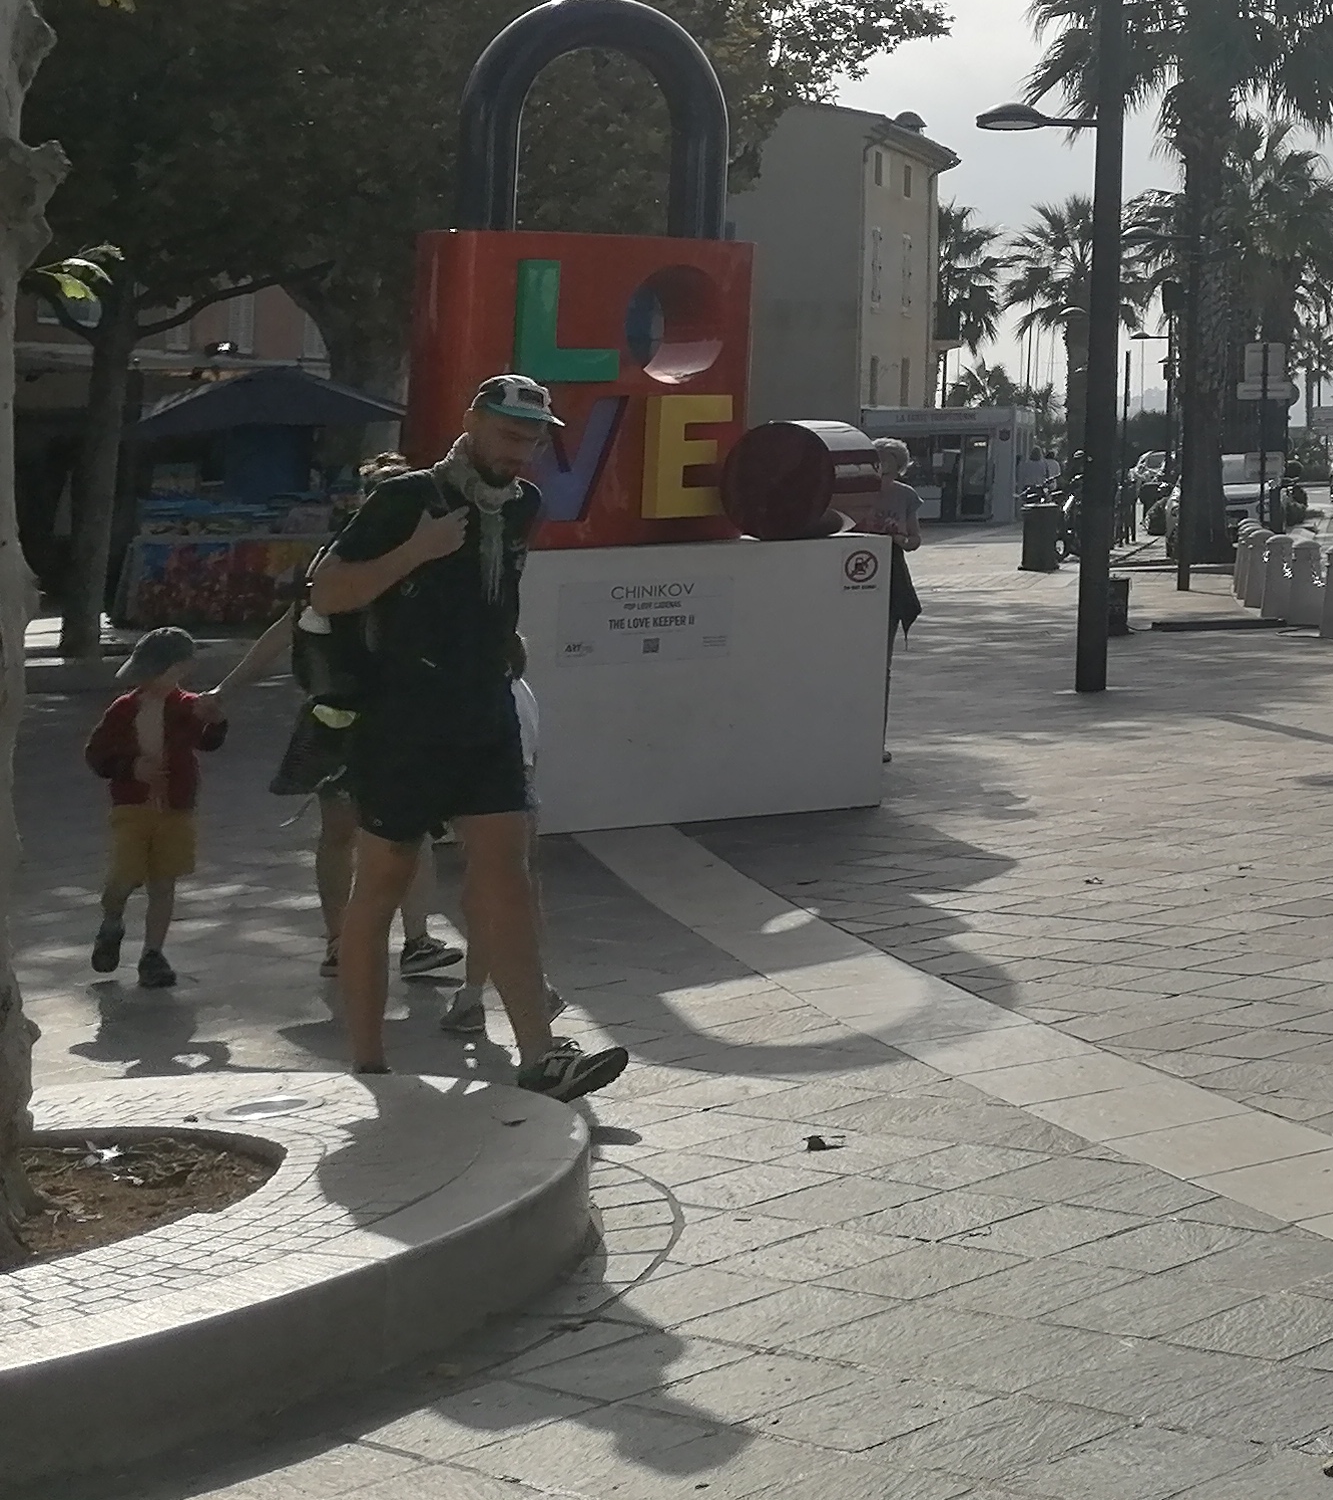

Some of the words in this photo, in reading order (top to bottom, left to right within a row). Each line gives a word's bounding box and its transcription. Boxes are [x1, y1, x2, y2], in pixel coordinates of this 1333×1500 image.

[611, 583, 695, 600] CHINIKOV
[608, 618, 625, 630] THE
[627, 617, 650, 629] LOVE
[652, 615, 686, 628] KEEPER
